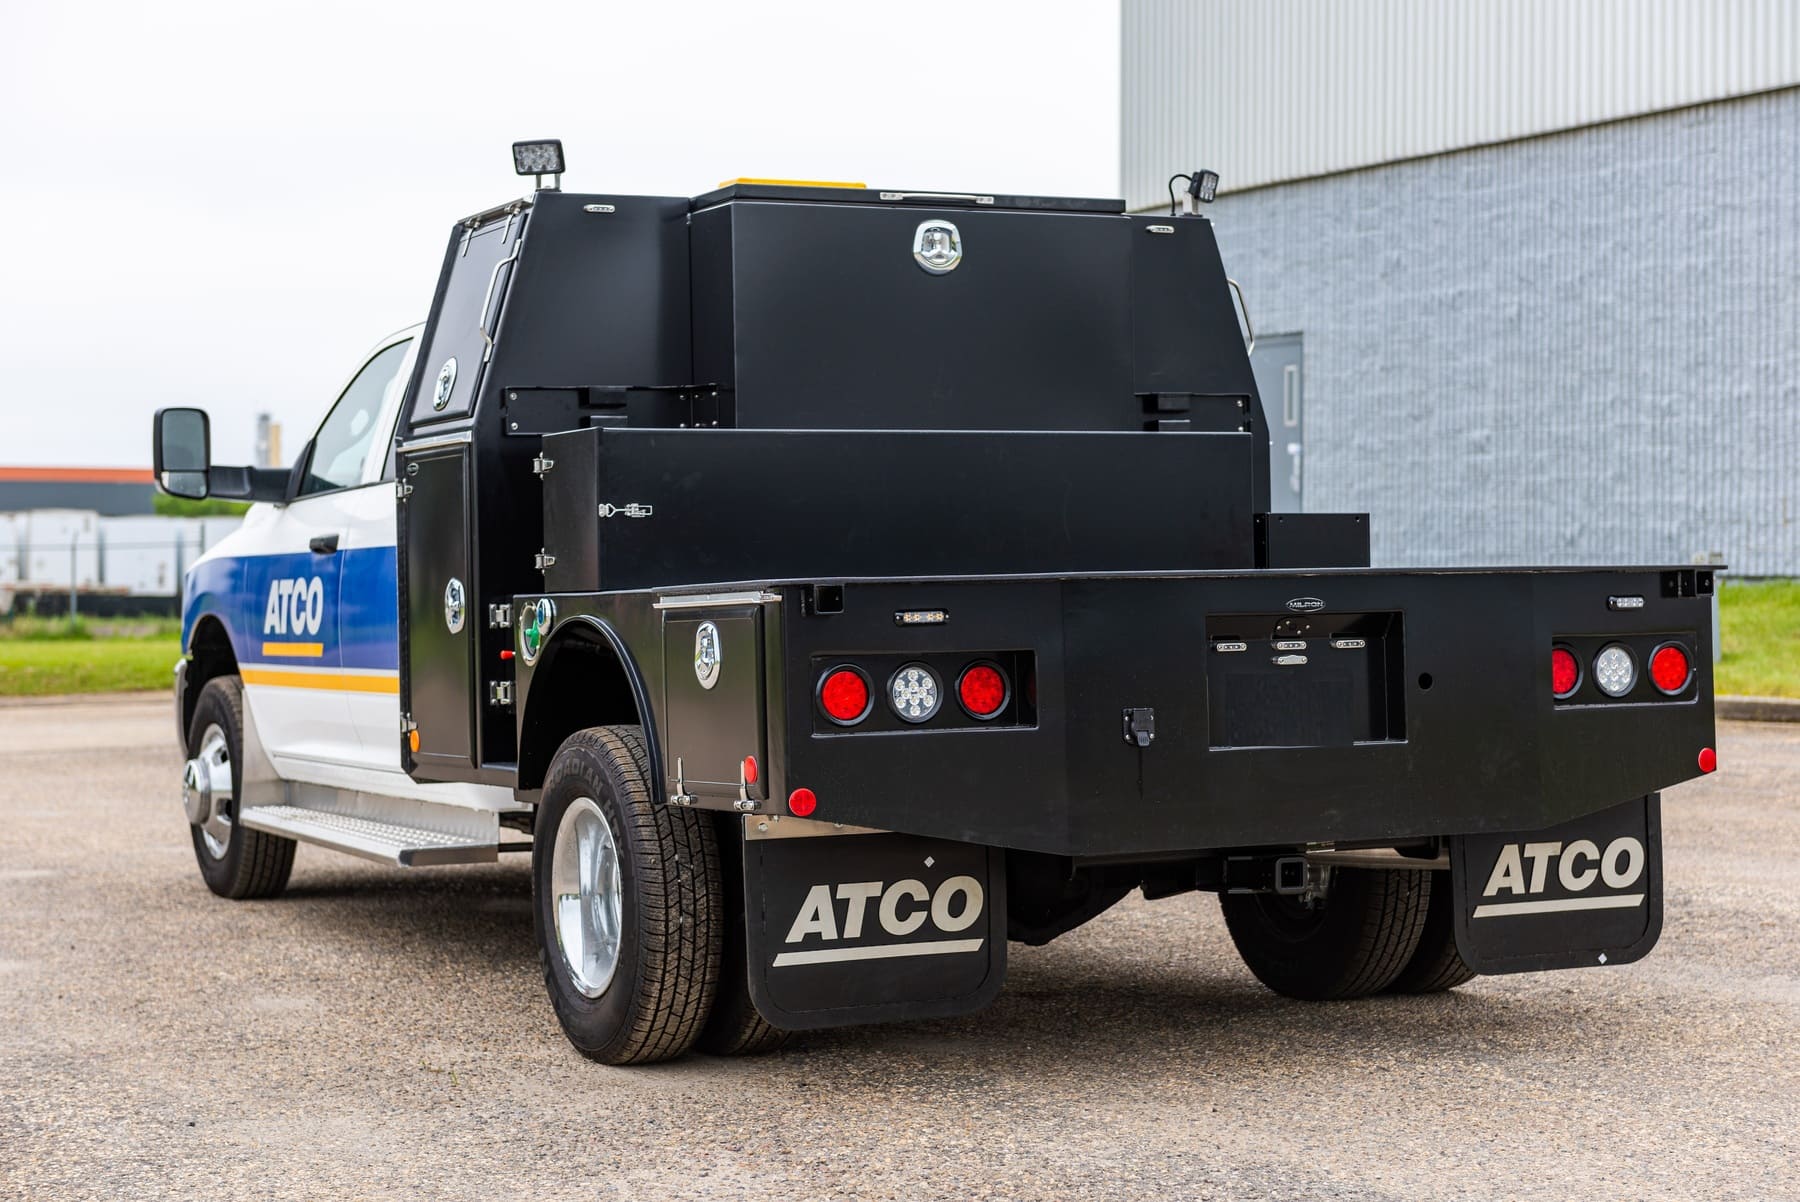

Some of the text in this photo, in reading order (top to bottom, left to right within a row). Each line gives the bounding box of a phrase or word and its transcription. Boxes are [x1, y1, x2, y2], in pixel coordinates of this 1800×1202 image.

[263, 575, 324, 636] ATCO
[1482, 836, 1645, 897] ATCO
[785, 875, 984, 944] ATCO
